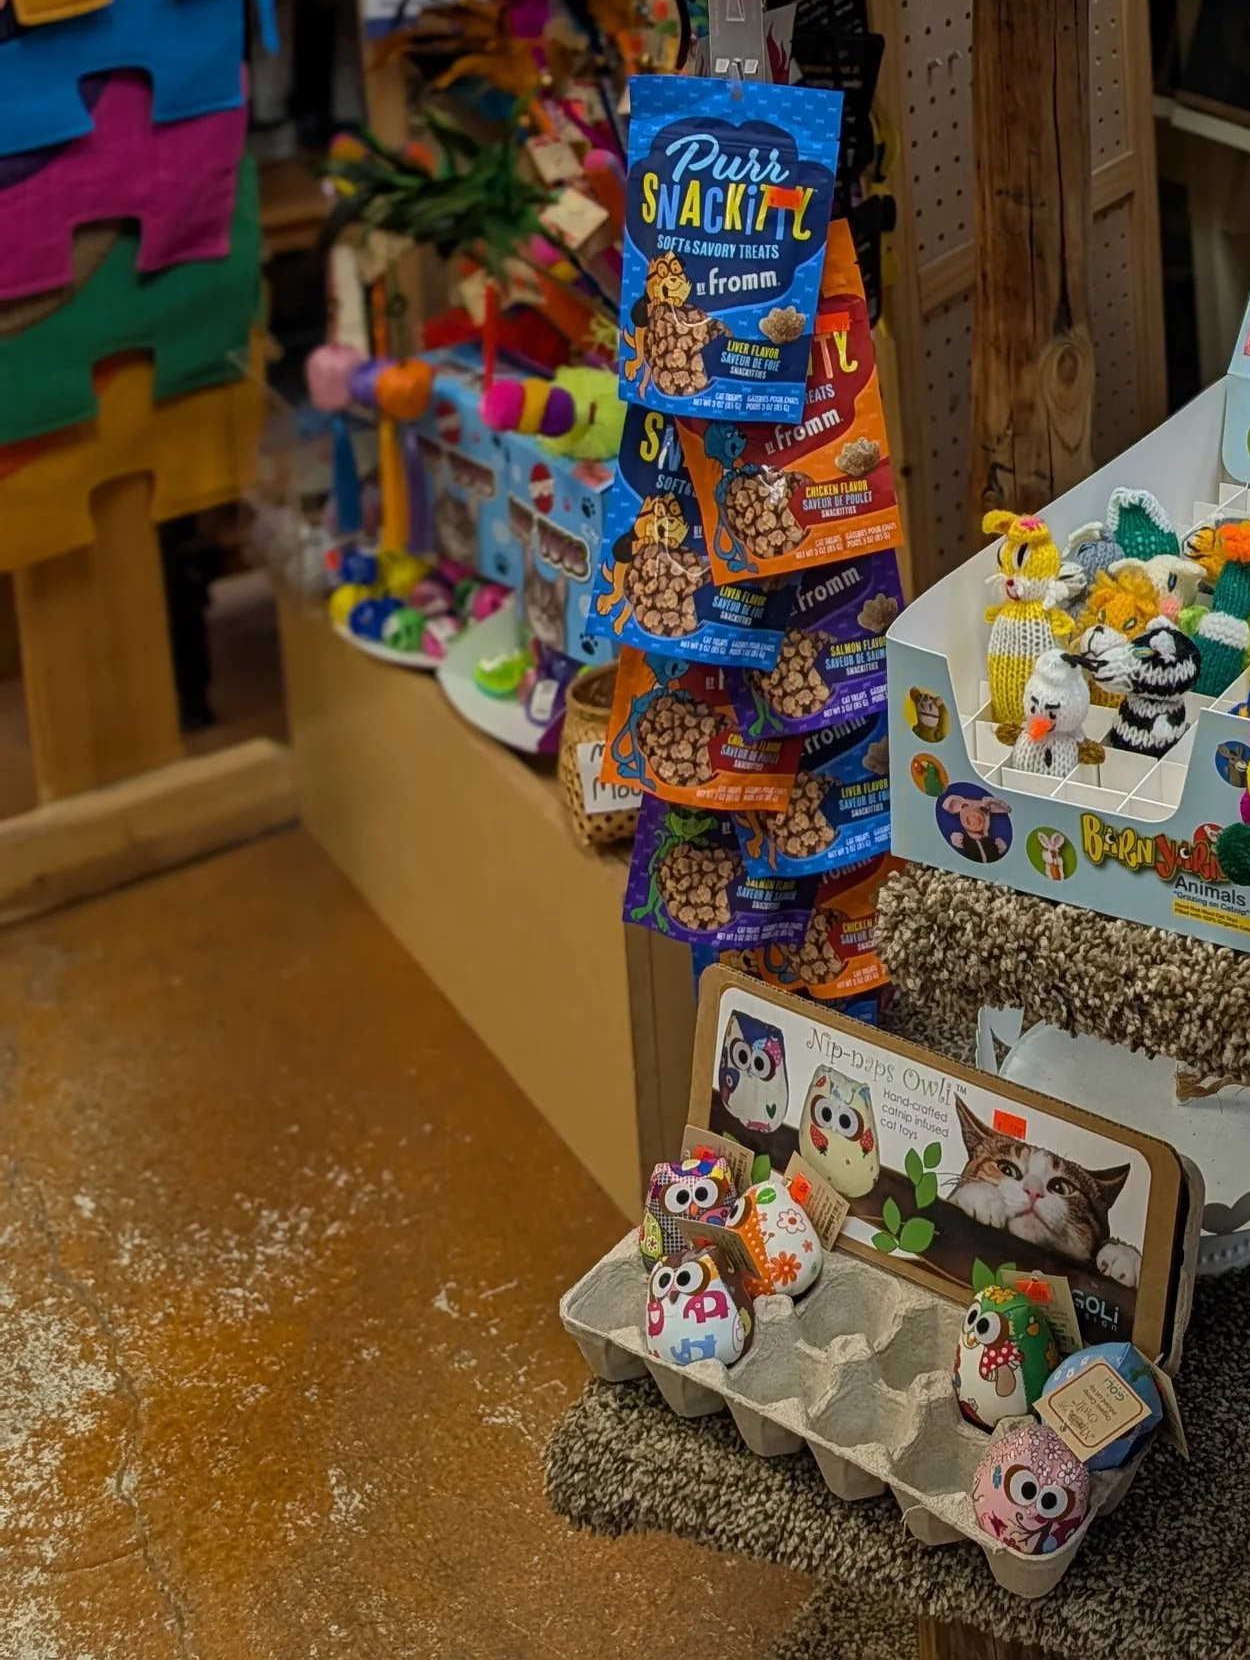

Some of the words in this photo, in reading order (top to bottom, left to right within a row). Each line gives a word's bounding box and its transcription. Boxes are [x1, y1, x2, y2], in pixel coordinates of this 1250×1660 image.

[665, 134, 790, 184] Purr
[739, 244, 779, 259] TREATS
[726, 340, 750, 354] LIVER
[751, 343, 779, 359] FLAVOR
[720, 351, 750, 365] SAVEUR
[764, 358, 781, 371] FOIE
[806, 483, 839, 498] CHICKEN
[840, 480, 868, 494] FLAVOR
[802, 495, 832, 511] SAVEUR
[846, 491, 872, 504] POULET
[1175, 875, 1246, 906] Animals
[883, 1089, 948, 1122] Hand-crafted
[880, 1117, 897, 1131] cat
[899, 1123, 918, 1140] toys
[882, 1104, 913, 1123] catnip
[914, 1115, 949, 1138] infused
